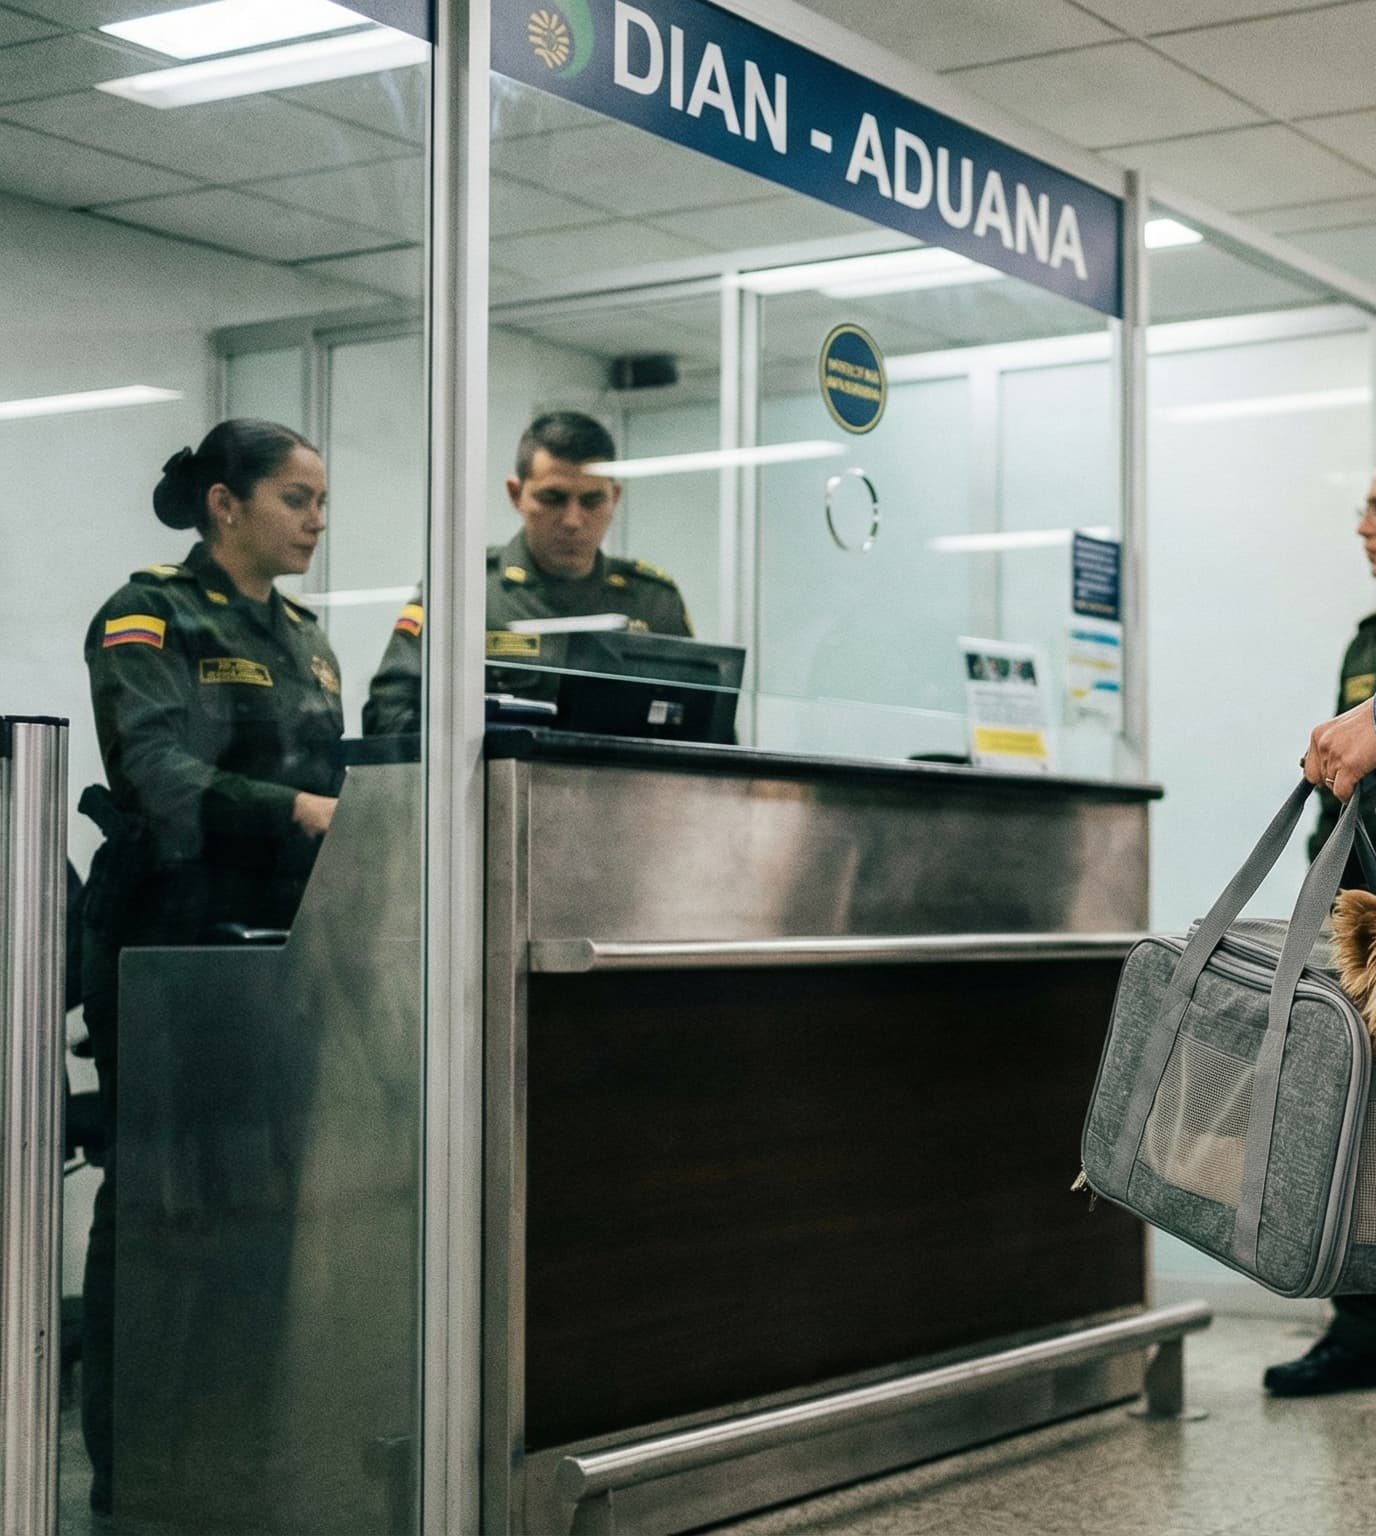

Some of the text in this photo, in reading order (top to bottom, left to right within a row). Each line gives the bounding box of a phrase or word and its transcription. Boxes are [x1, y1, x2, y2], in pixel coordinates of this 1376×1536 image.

[613, 1, 1086, 279] DIAN - ADUANA
